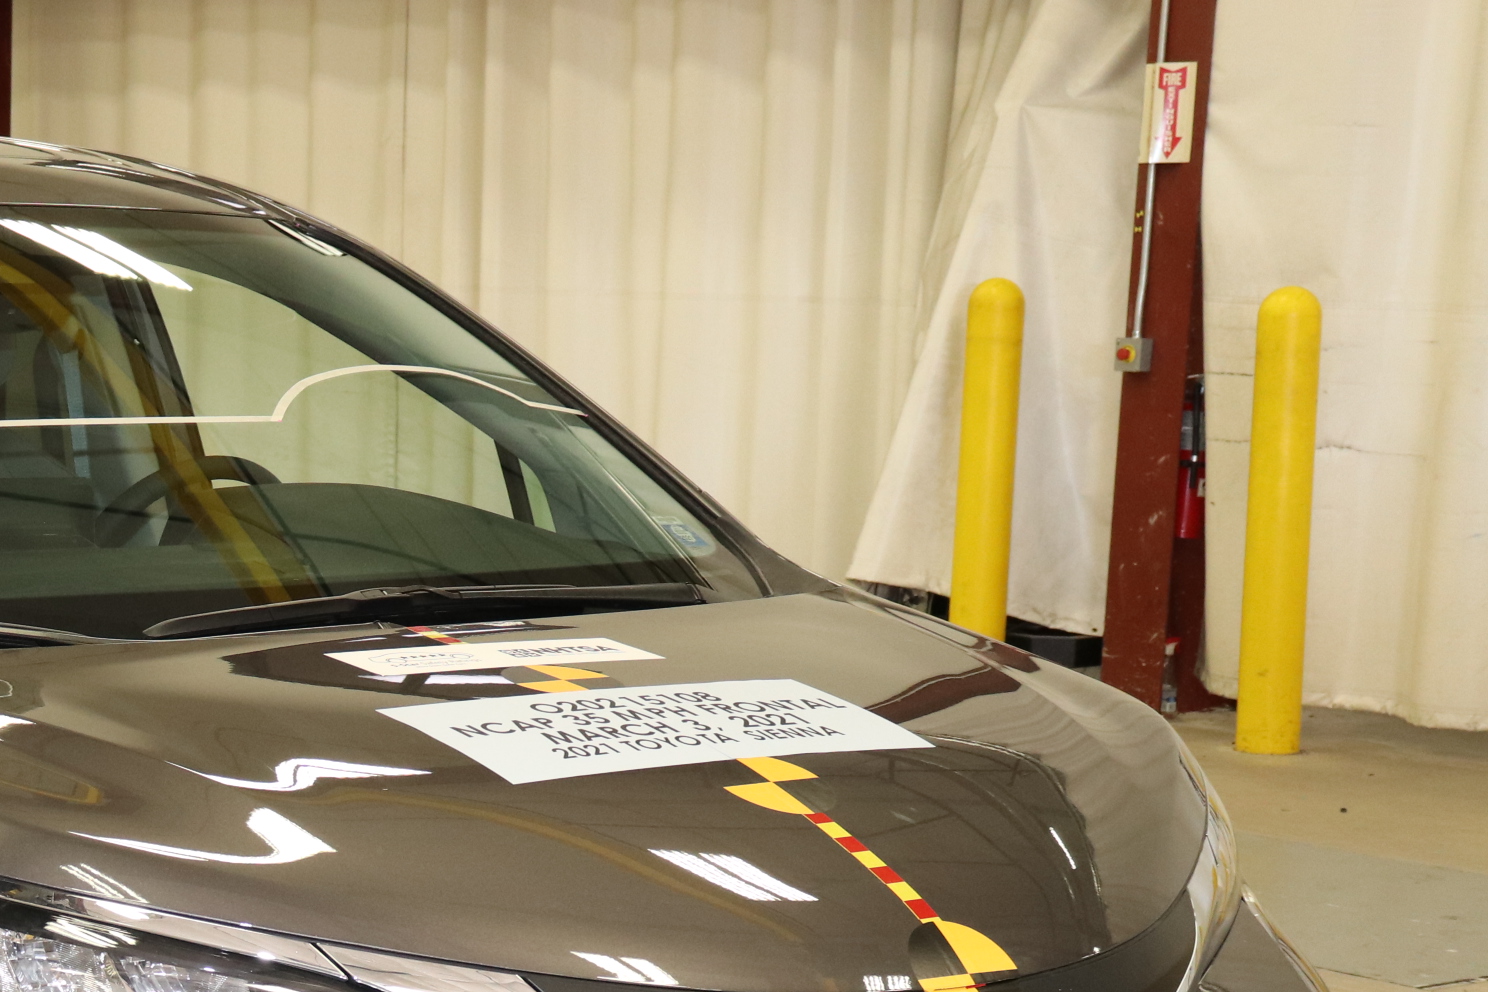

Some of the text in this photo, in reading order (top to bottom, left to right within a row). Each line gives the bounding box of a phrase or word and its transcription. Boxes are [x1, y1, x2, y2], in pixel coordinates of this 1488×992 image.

[449, 698, 847, 738] NCAP 35 MPH FRONTAL
[541, 712, 811, 745] MARCH 3, 2021
[551, 725, 845, 759] 2021 TOYOTA SIENNA
